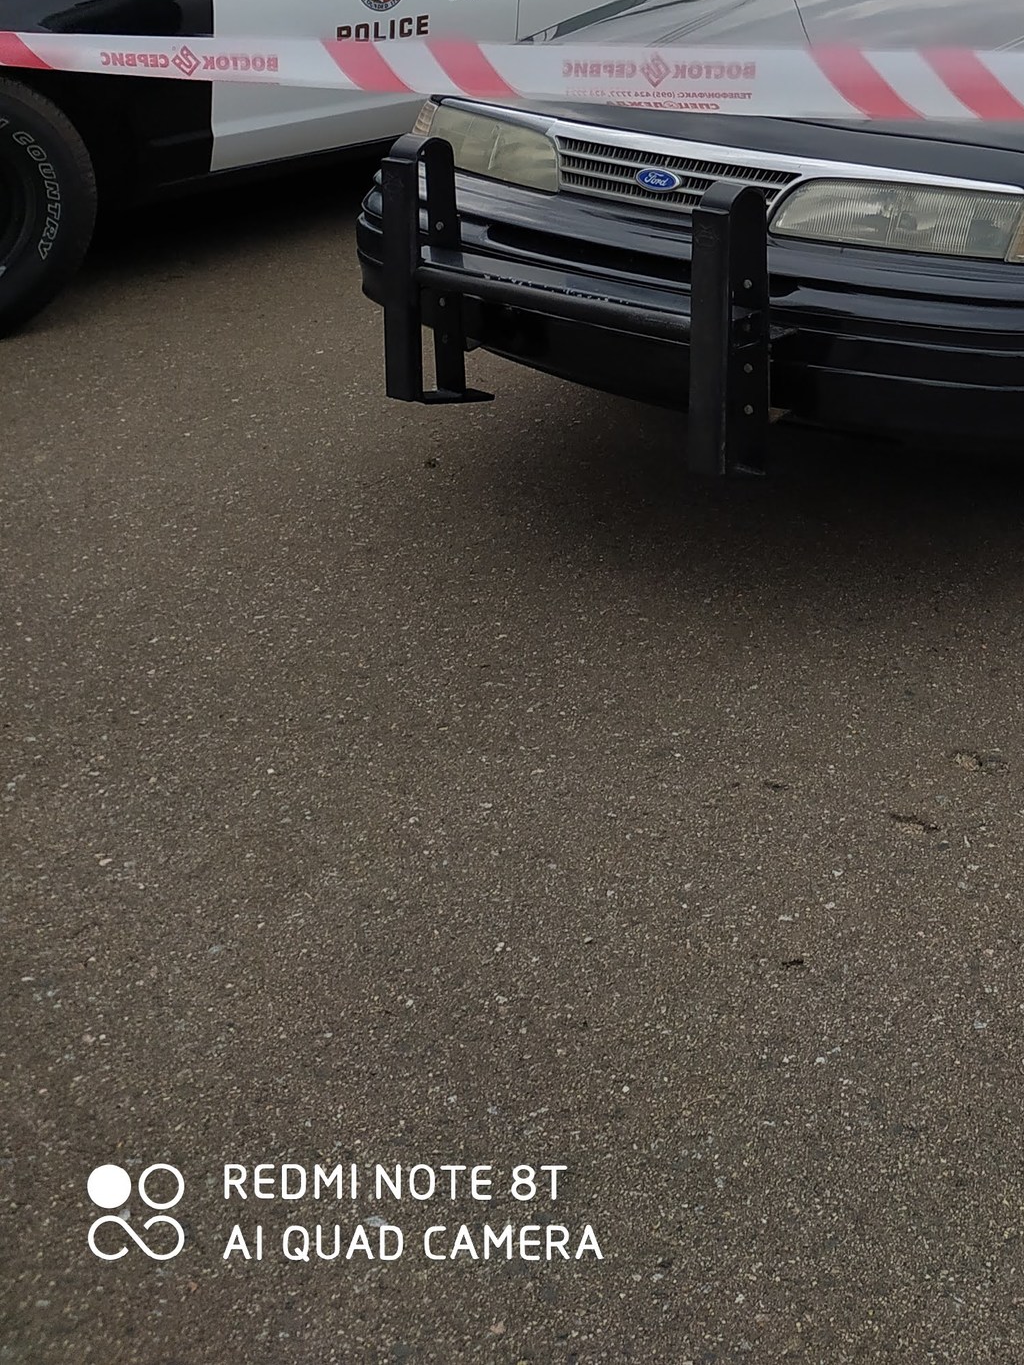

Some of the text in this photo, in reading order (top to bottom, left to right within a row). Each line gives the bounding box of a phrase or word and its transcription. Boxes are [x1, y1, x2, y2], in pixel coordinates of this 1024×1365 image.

[336, 15, 430, 42] POLICE
[644, 171, 669, 187] Ford
[12, 130, 62, 261] COUNTRY
